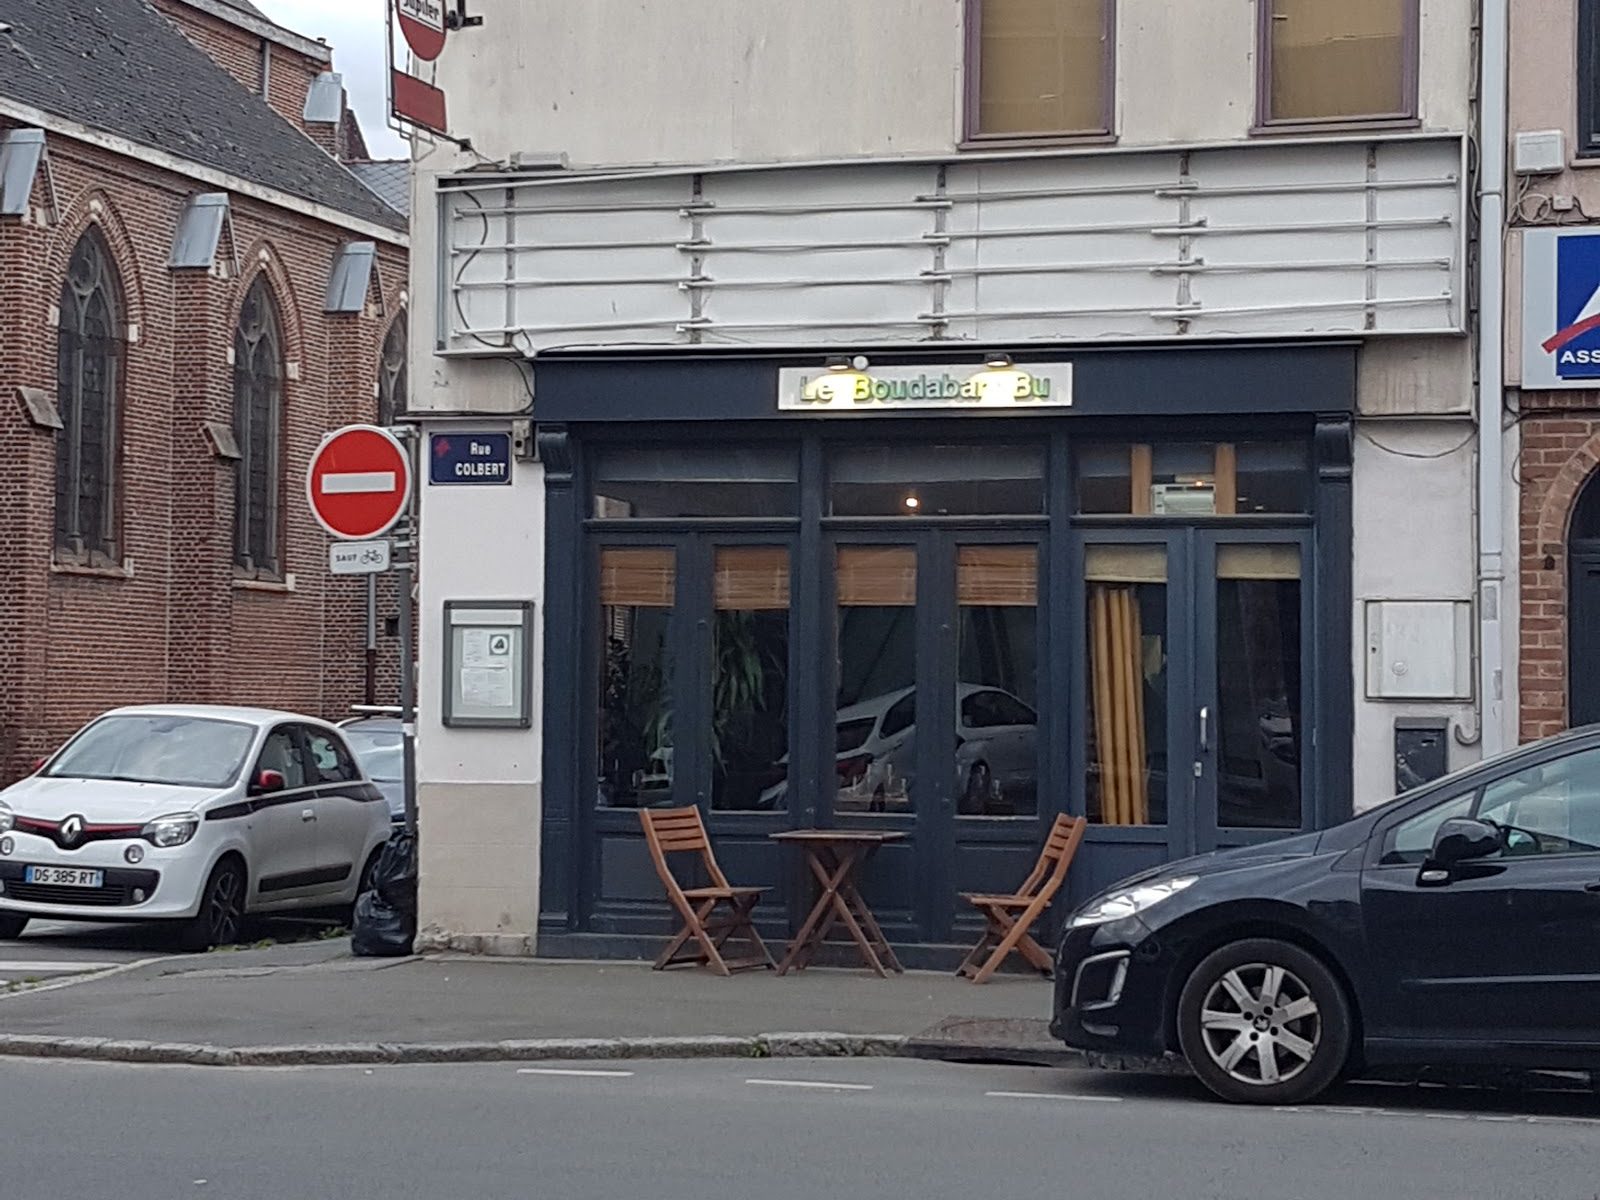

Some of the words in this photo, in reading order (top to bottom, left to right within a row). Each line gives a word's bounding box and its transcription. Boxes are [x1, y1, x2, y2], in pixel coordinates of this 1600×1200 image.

[800, 376, 834, 402] Le
[853, 373, 988, 402] Boudabar
[1013, 375, 1051, 401] Bu
[455, 462, 506, 476] COLBERT
